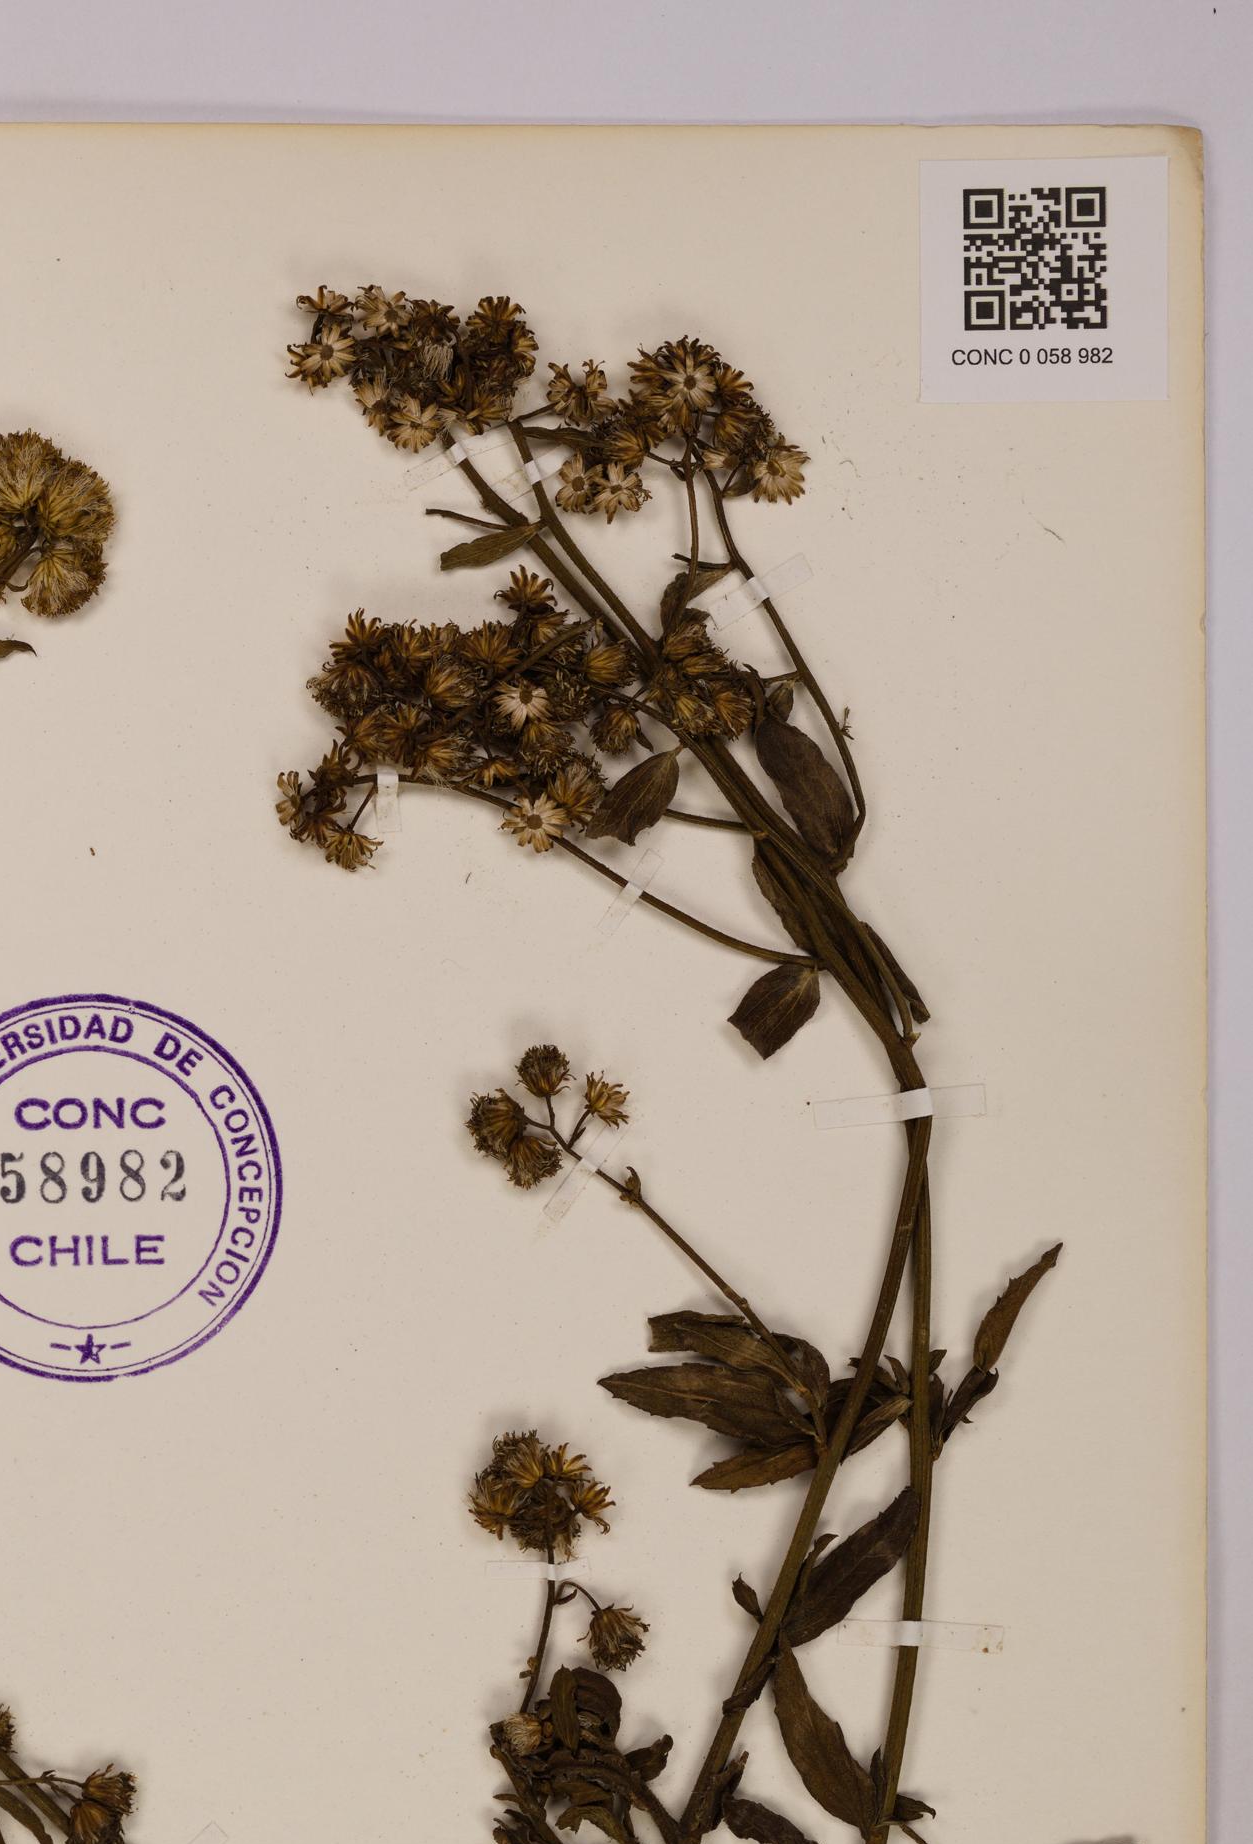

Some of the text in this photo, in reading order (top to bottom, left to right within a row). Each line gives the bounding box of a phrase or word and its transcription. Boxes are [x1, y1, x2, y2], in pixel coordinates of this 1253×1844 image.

[951, 347, 1113, 366] CONC 0 058 982
[13, 1097, 166, 1131] CONC
[153, 1031, 204, 1077] DE
[197, 1084, 264, 1307] CONCEPCION
[9, 1235, 165, 1267] CHILE
